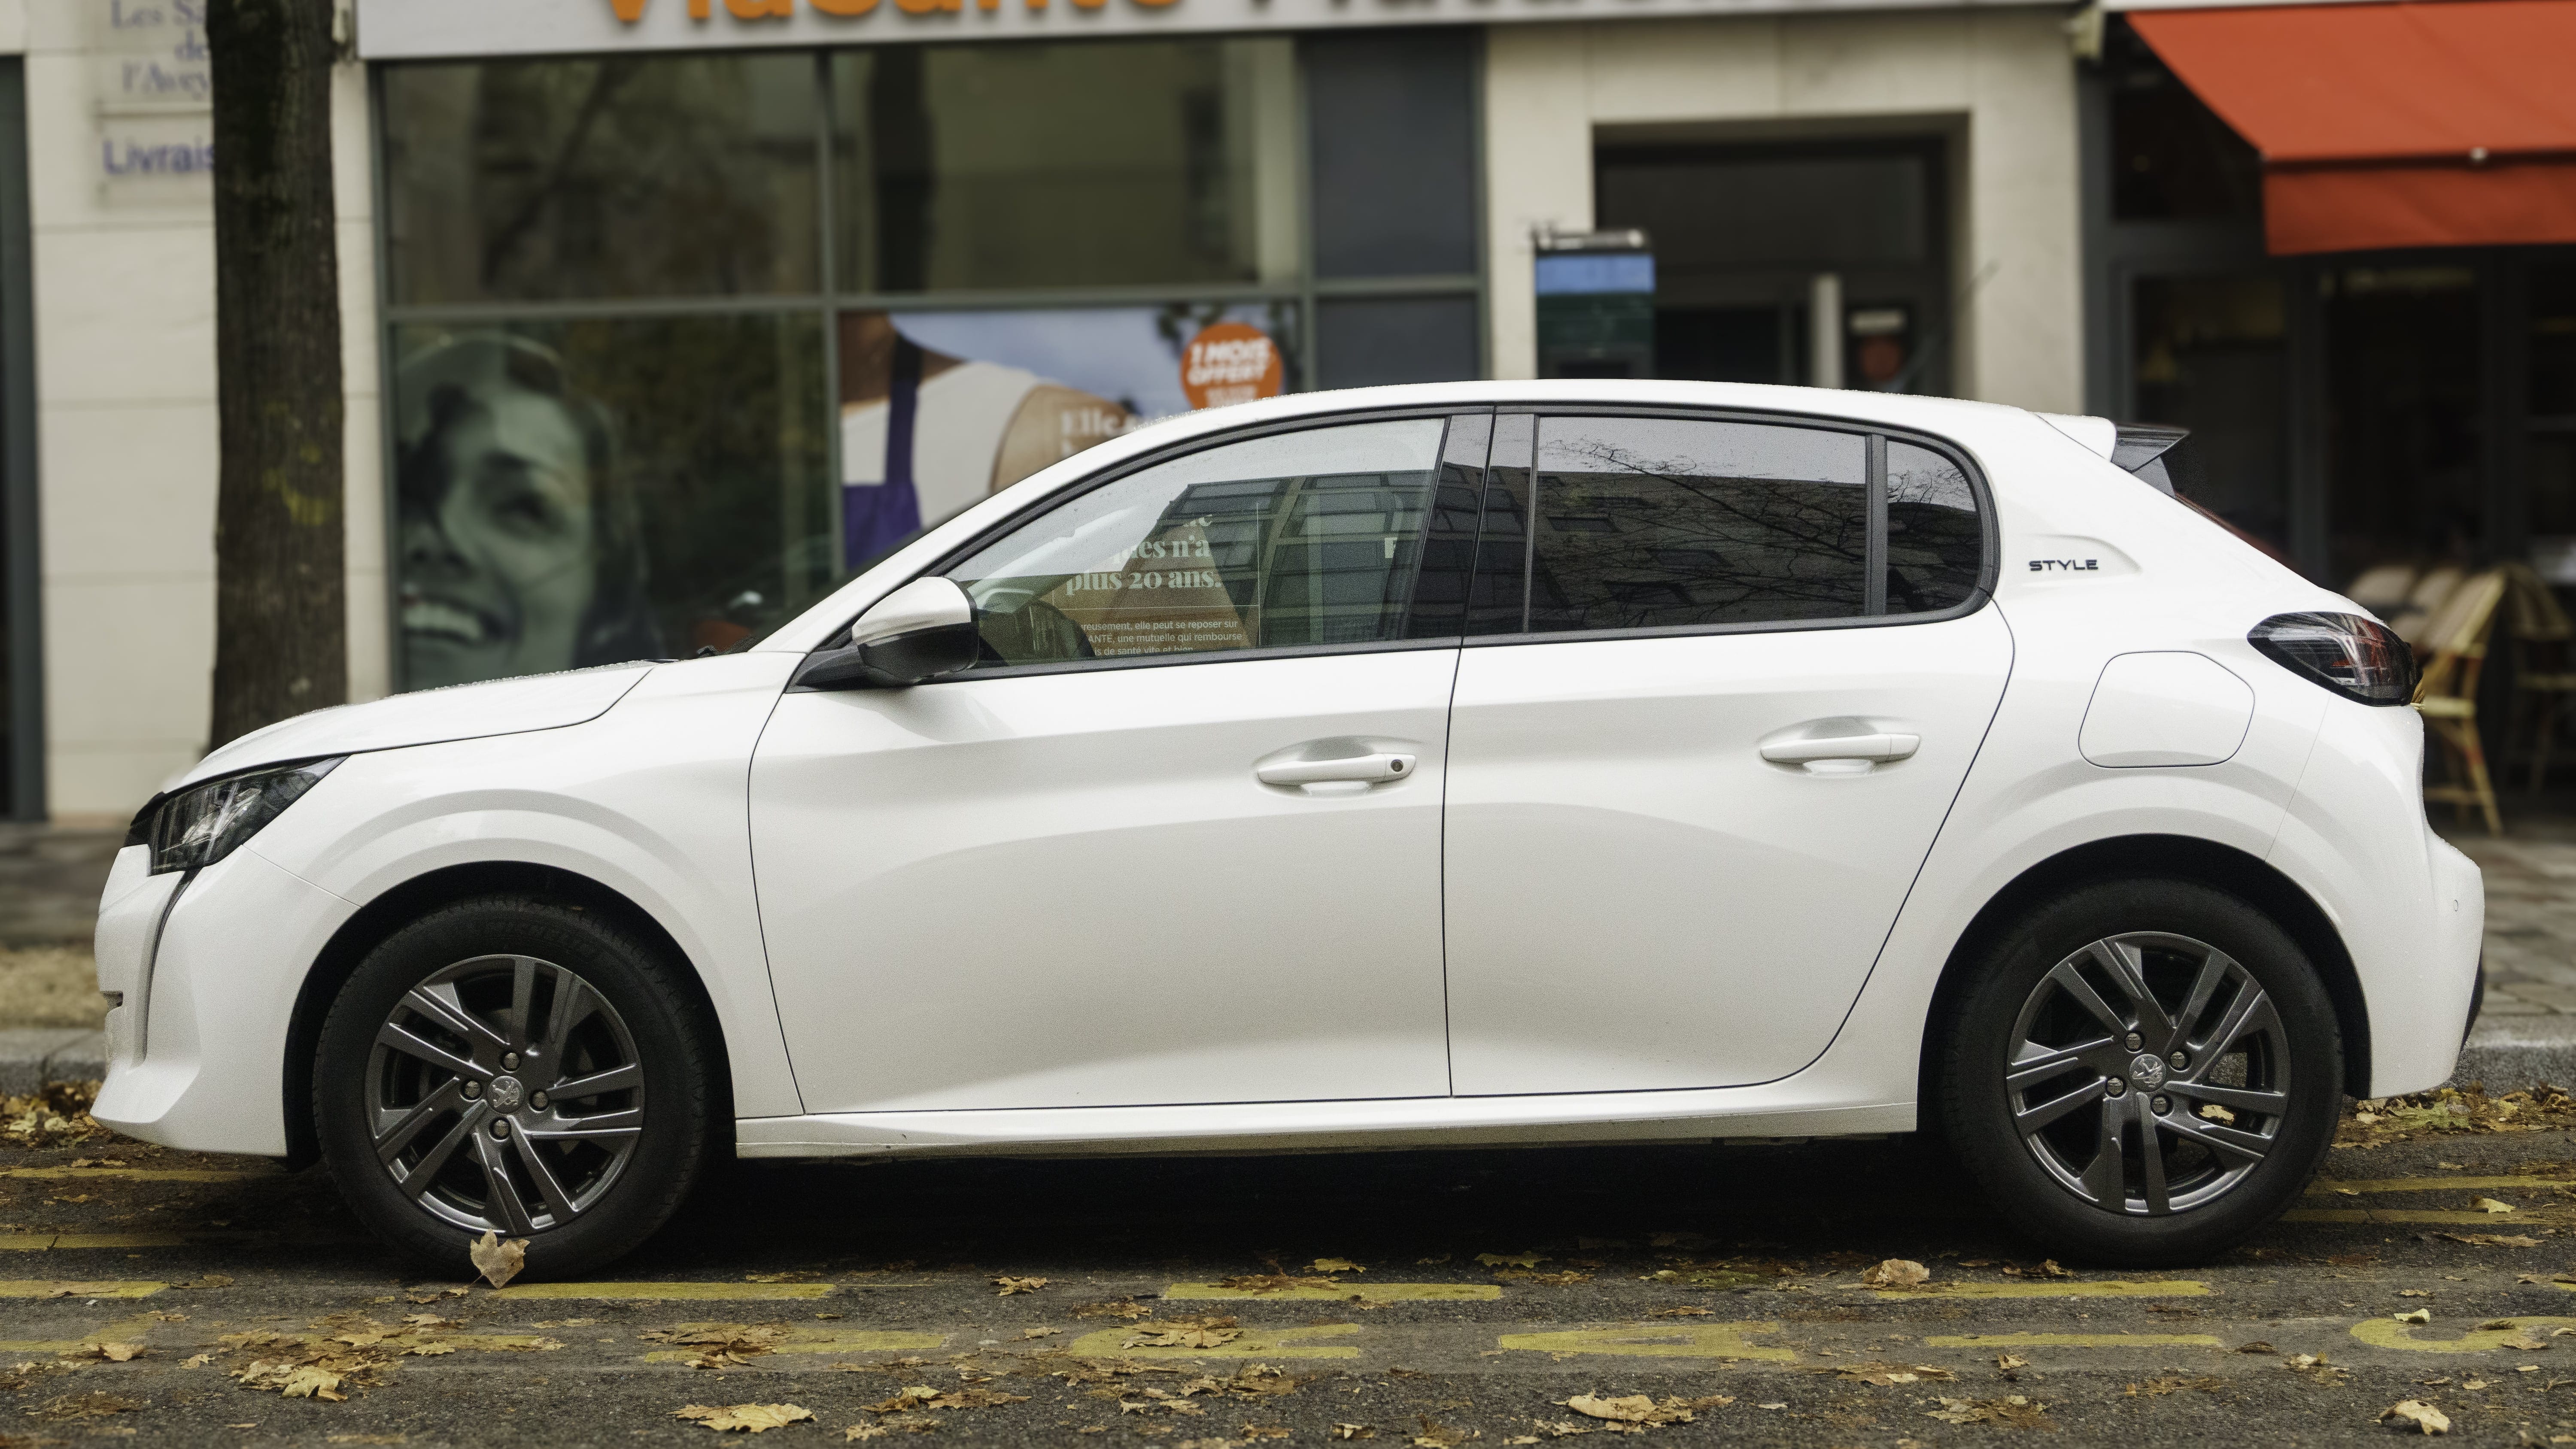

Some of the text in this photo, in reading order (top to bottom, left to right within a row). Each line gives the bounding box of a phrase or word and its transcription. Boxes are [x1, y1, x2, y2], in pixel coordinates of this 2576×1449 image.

[2029, 559, 2099, 571] STYLE
[1066, 570, 1222, 595] plus 20 ans.
[1135, 621, 1151, 630] elle
[1153, 621, 1173, 631] peut
[1188, 621, 1221, 630] reposer
[1137, 633, 1175, 642] mutuelle
[1177, 632, 1191, 642] qui
[1194, 632, 1242, 641] rembourse
[1103, 647, 1115, 655] de
[1117, 646, 1141, 655] santé
